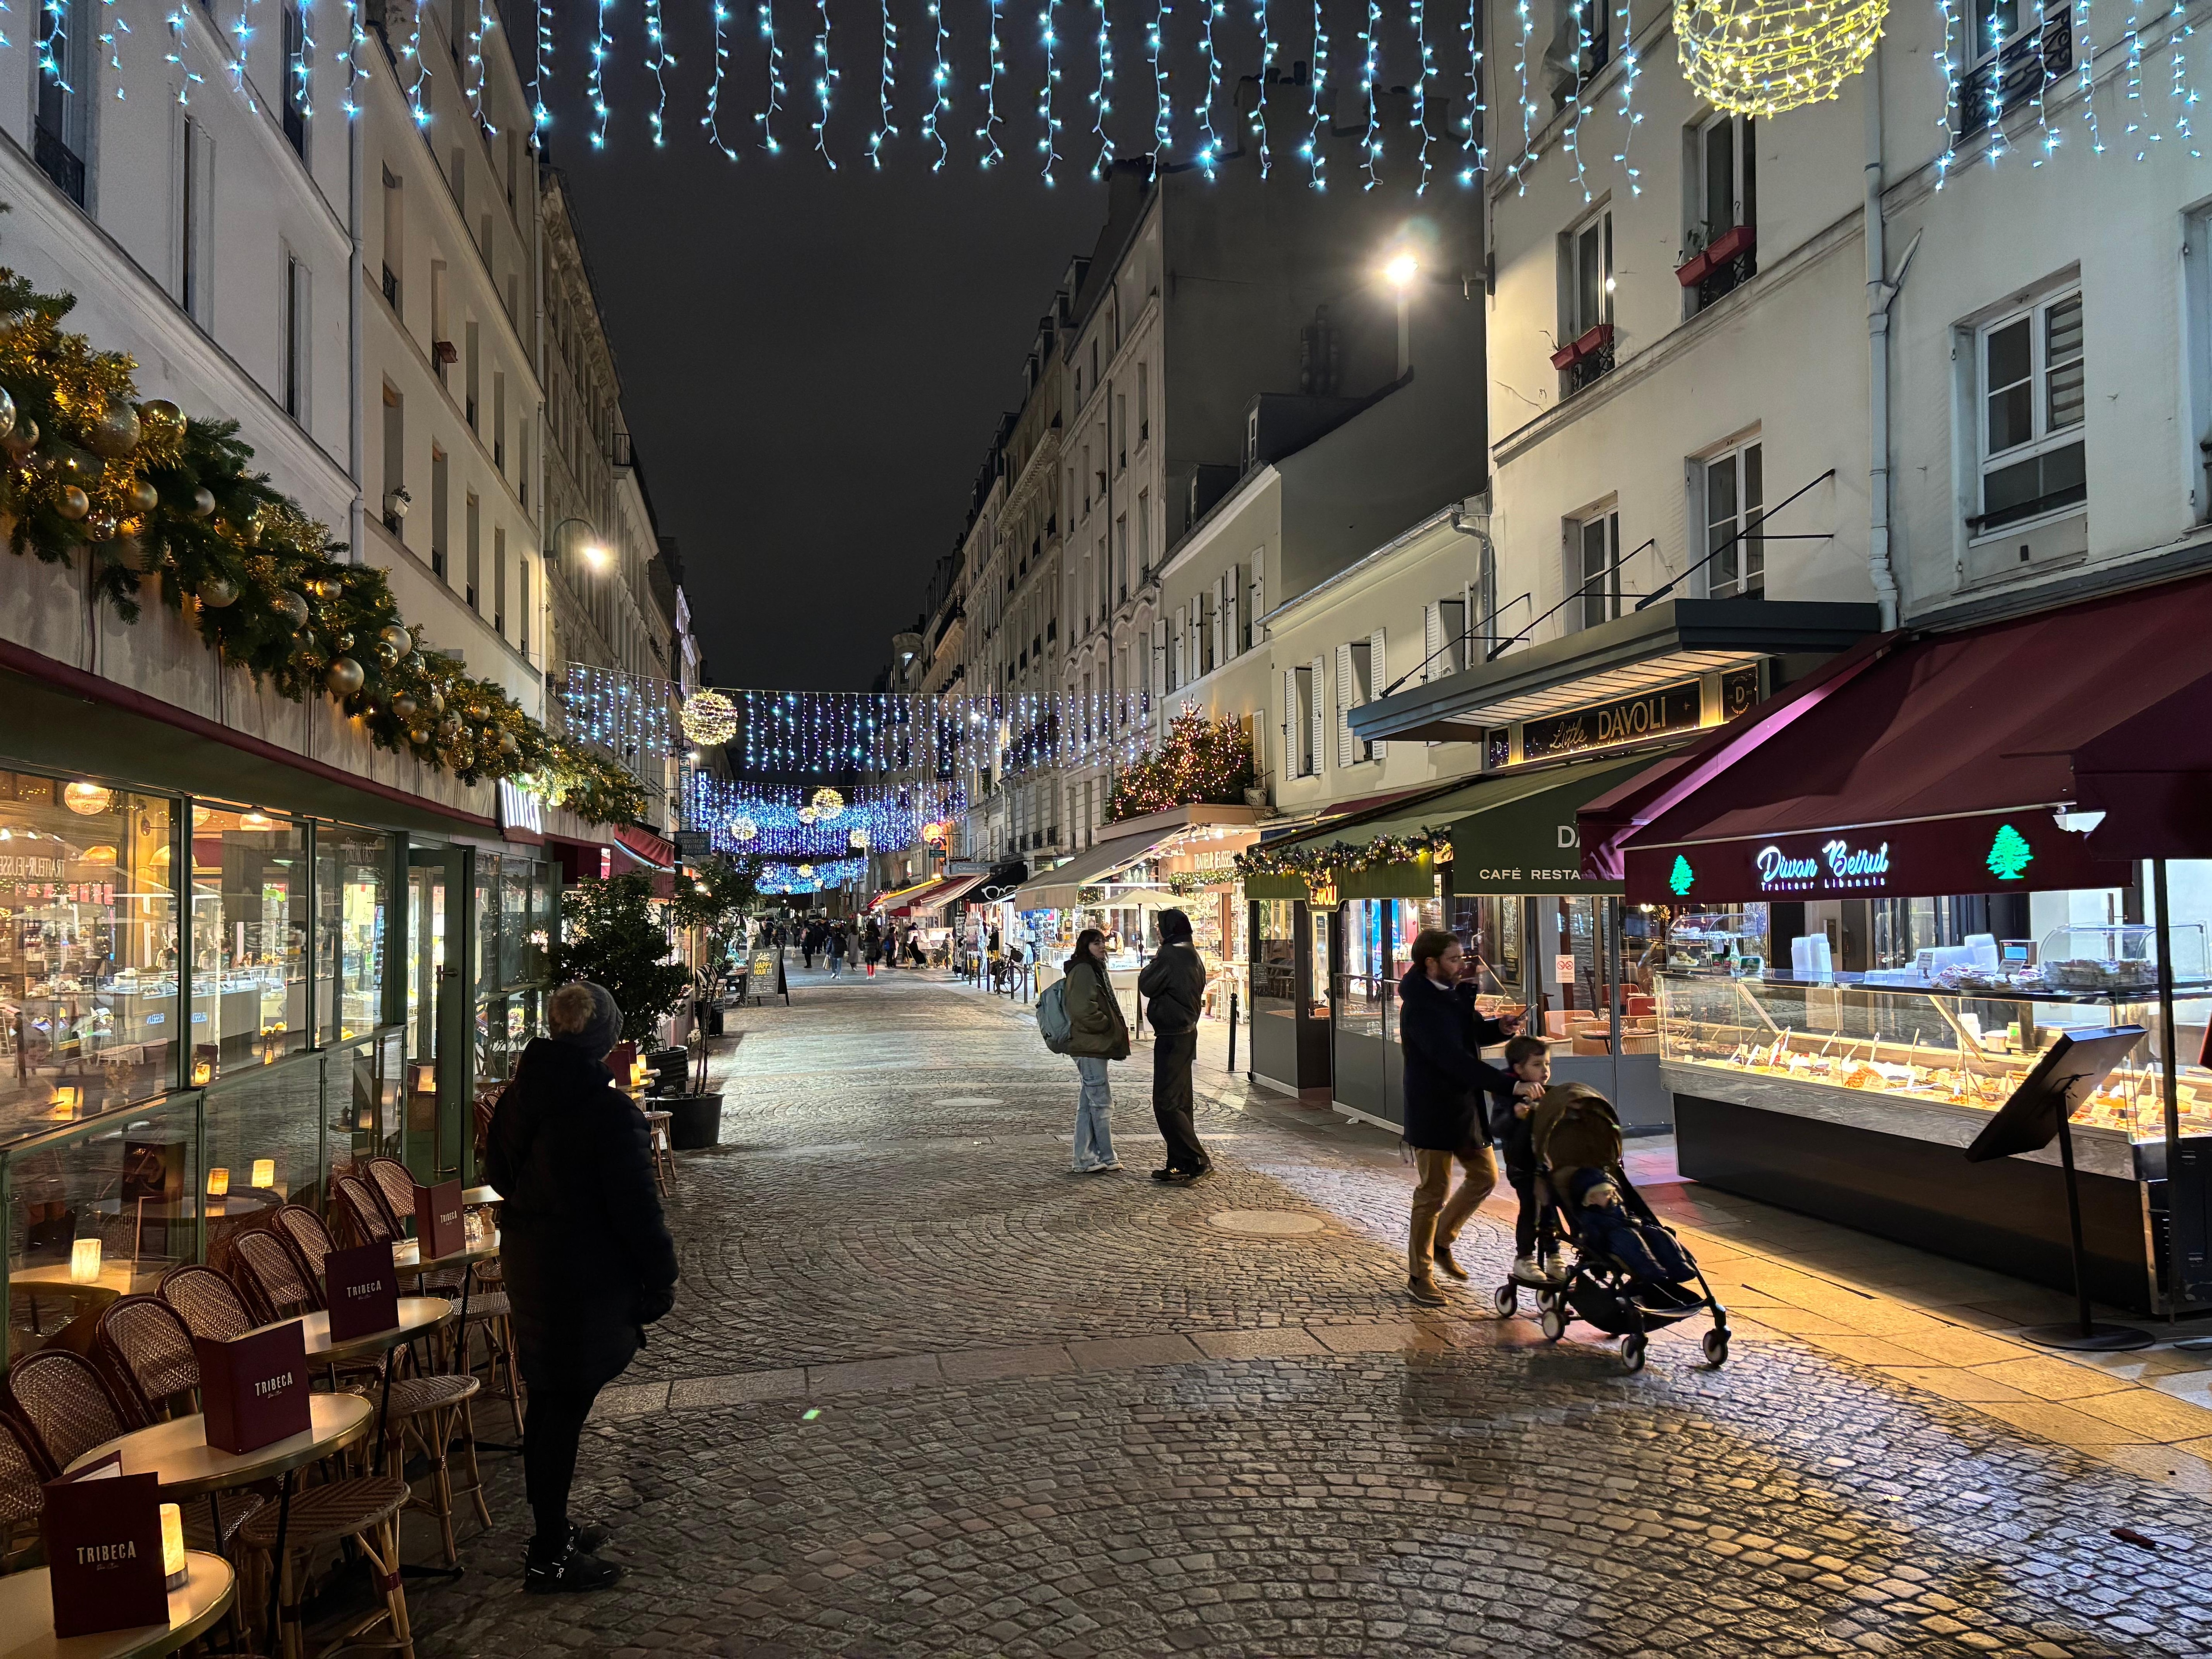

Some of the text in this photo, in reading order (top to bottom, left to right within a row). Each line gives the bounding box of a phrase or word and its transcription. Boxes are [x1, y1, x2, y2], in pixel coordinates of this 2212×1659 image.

[1549, 696, 1666, 749] Little DAVOLI
[698, 772, 707, 821] HOTEL
[1557, 825, 1580, 848] D
[1194, 851, 1214, 870] TRAITEUR
[1757, 840, 1889, 882] Diwan Beirut
[1479, 867, 1581, 880] CAFÉ RESTA
[346, 1280, 381, 1298] TRIBECA
[255, 1372, 293, 1396] TRIBECA
[77, 1541, 136, 1564] TRIBECA
